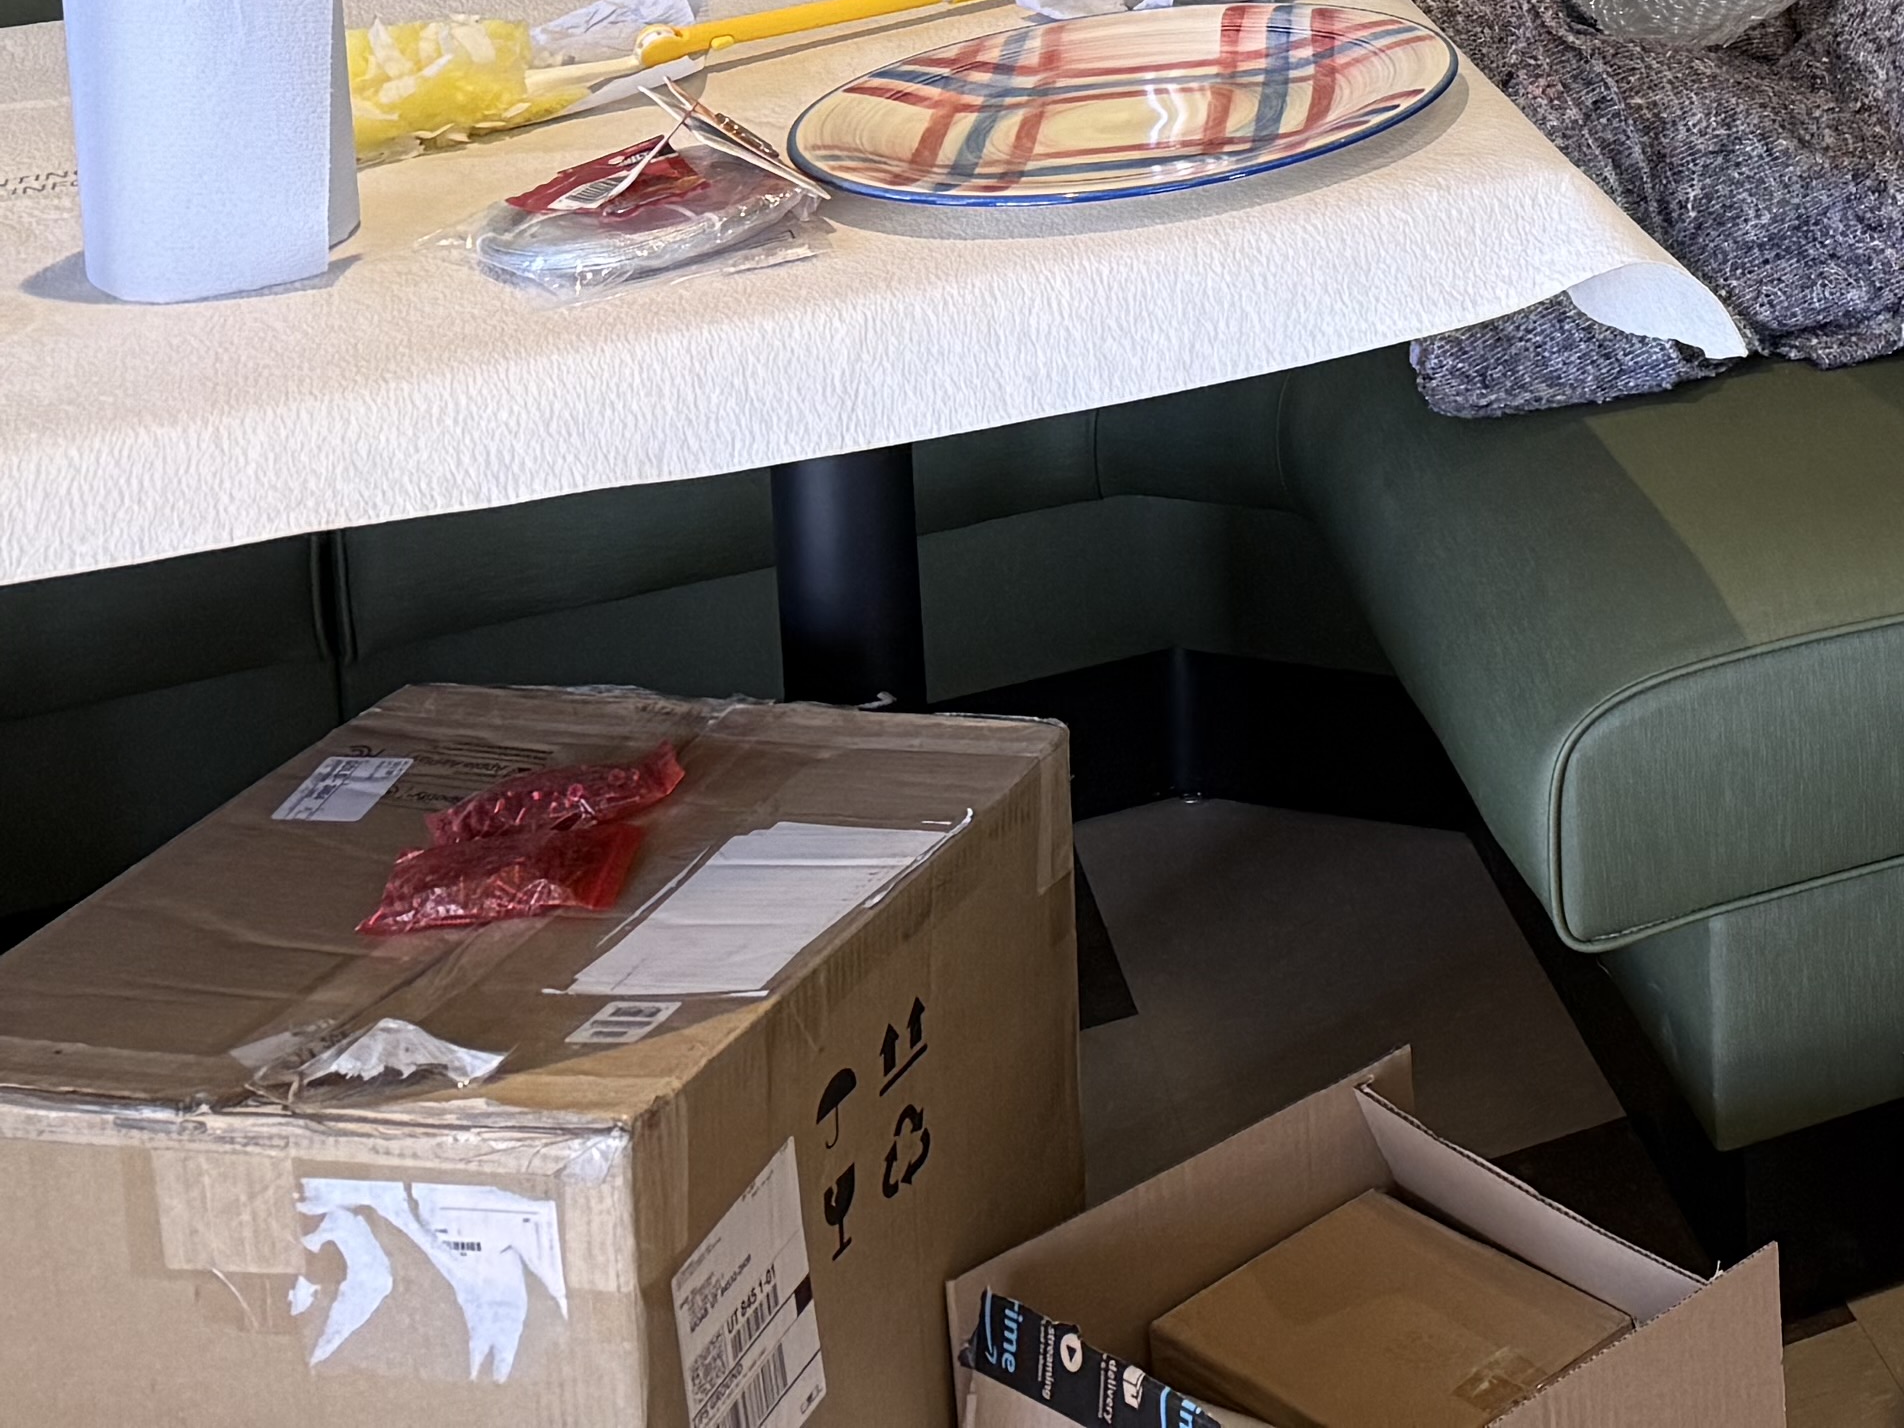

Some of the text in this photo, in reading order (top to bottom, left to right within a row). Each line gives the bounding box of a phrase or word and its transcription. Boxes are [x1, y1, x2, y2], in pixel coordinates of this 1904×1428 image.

[726, 1263, 777, 1335] UT 845 1-01
[1041, 1324, 1055, 1401] streaming
[1103, 1359, 1118, 1424] delivery
